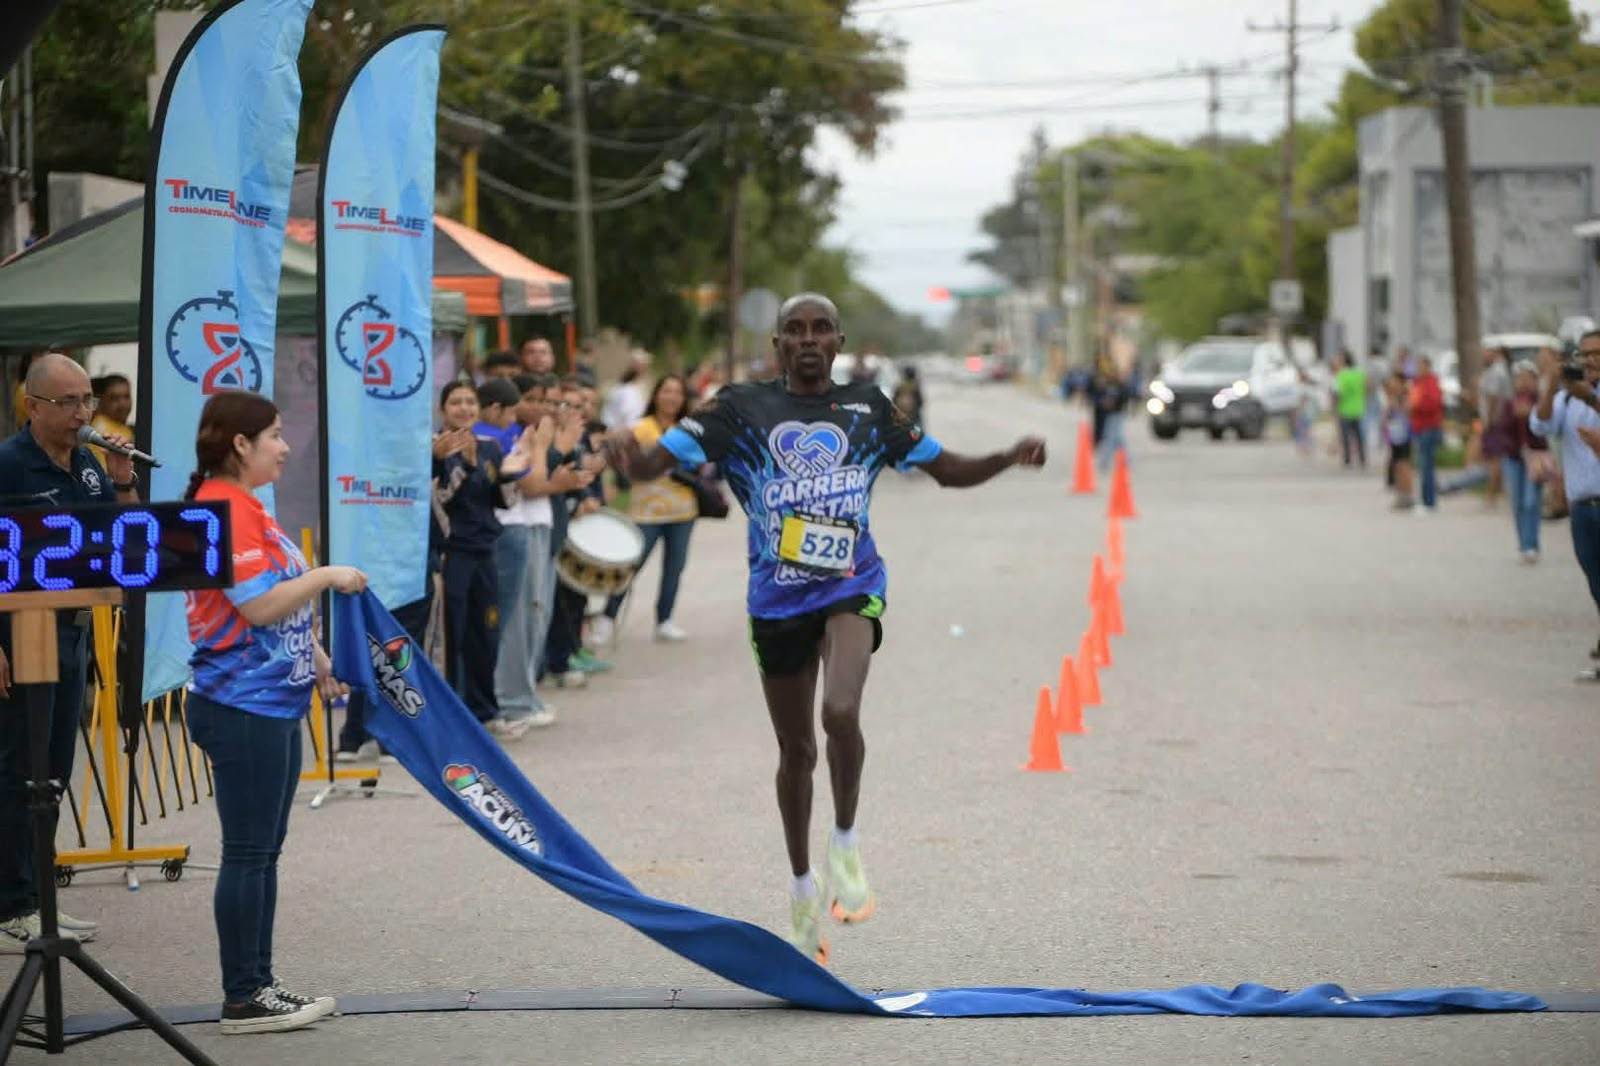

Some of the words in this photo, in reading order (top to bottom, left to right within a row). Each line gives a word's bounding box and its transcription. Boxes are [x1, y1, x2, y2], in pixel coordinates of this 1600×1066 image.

[764, 470, 866, 508] CARRERA
[801, 532, 849, 560] 528
[459, 782, 540, 854] ACUÑA
